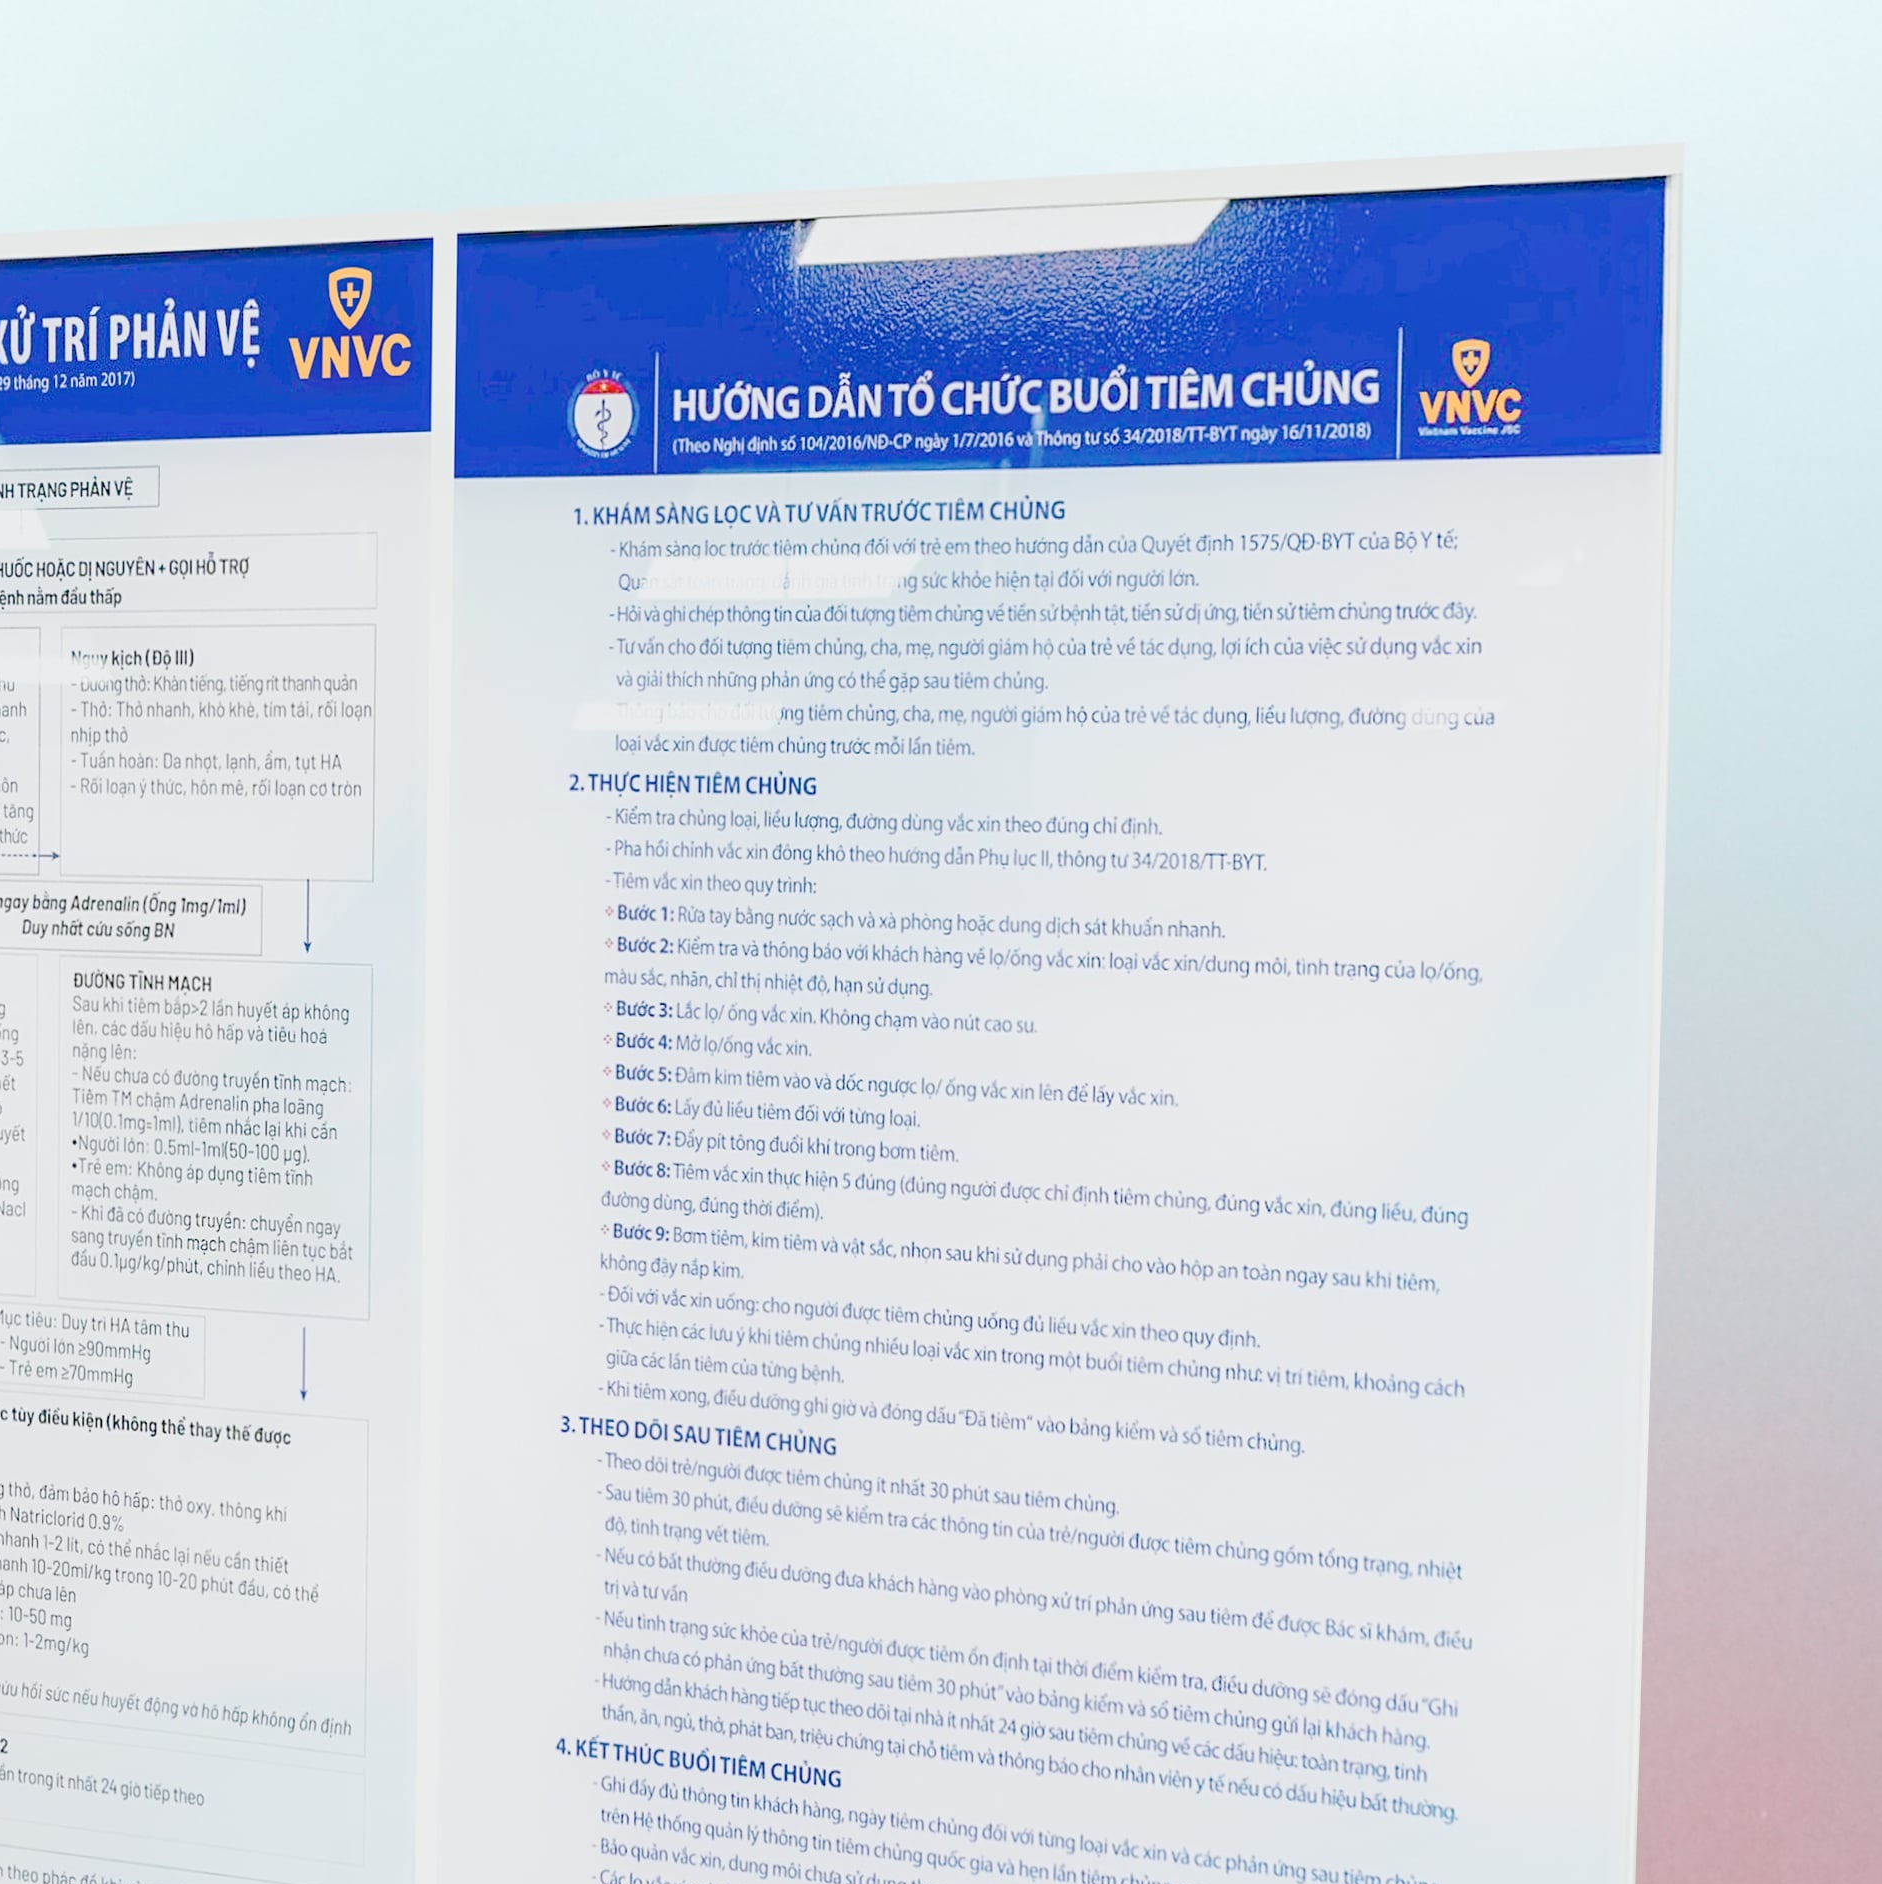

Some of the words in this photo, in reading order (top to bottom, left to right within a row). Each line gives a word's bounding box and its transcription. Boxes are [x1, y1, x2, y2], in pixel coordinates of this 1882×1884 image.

[42, 306, 101, 363] TRÍ
[109, 297, 207, 361] PHẢN
[216, 298, 261, 369] VỆ
[289, 332, 411, 381] VNVC
[13, 373, 50, 394] tháng
[53, 372, 68, 390] 12
[70, 371, 98, 389] năm
[100, 370, 136, 389] 2017)
[672, 379, 800, 423] HƯỚNG
[807, 371, 882, 420] DẪN
[887, 369, 936, 419] TỔ
[941, 371, 1045, 418] CHỨC
[1049, 362, 1140, 415] BUỔI
[1144, 366, 1234, 411] TIÊM
[1241, 358, 1380, 409] CHỦNG
[1419, 389, 1523, 424] VNVC
[672, 436, 711, 458] (Theo
[713, 434, 746, 457] Nghị
[746, 434, 778, 456] định
[780, 433, 797, 452] số
[800, 432, 913, 452] 104/2016/NĐ-CP
[914, 431, 950, 453] ngày
[952, 430, 1015, 450] 1/7/2016
[1017, 435, 1036, 450] và
[1083, 429, 1102, 447] tư
[1103, 426, 1121, 447] số
[1122, 423, 1239, 445] 34/2018/TT-BYT
[1240, 424, 1279, 446] ngày
[1281, 421, 1372, 442] 16/11/2018)
[17, 481, 68, 503] TRẠNG
[70, 474, 111, 499] PHẢN
[114, 476, 134, 502] VỆ
[574, 506, 588, 526] 1.
[593, 502, 651, 526] KHÁM
[655, 501, 709, 525] SÀNG
[714, 503, 752, 530] LỌC
[755, 500, 782, 524] VÀ
[784, 501, 814, 524] TƯ
[816, 499, 858, 523] VẤN
[861, 497, 932, 524] TRƯỚC
[935, 497, 985, 522] TIÊM
[989, 494, 1066, 521] CHỦNG
[36, 557, 76, 583] HOẶC
[78, 559, 92, 582] DỊ
[95, 555, 156, 578] NGUYÊN
[168, 558, 193, 580] GỌI
[219, 557, 250, 580] TRỢ
[569, 773, 585, 792] 2.
[587, 771, 641, 798] THỰC
[645, 770, 691, 799] HIỆN
[694, 771, 741, 795] TIÊM
[745, 770, 817, 796] CHỦNG
[73, 966, 126, 991] ĐƯỜNG
[130, 968, 166, 992] TĨNH
[168, 973, 211, 996] MẠCH
[560, 1414, 576, 1436] 3.
[579, 1416, 632, 1441] THEO
[634, 1417, 669, 1442] DÕI
[673, 1423, 711, 1446] SAU
[714, 1424, 761, 1450] TIÊM
[765, 1429, 837, 1457] CHỦNG
[555, 1737, 571, 1756] 4.
[576, 1736, 610, 1761] KẾT
[613, 1742, 665, 1768] THÚC
[669, 1747, 716, 1774] BUỔI
[719, 1753, 766, 1780] TIÊM
[770, 1759, 842, 1789] CHỦNG
